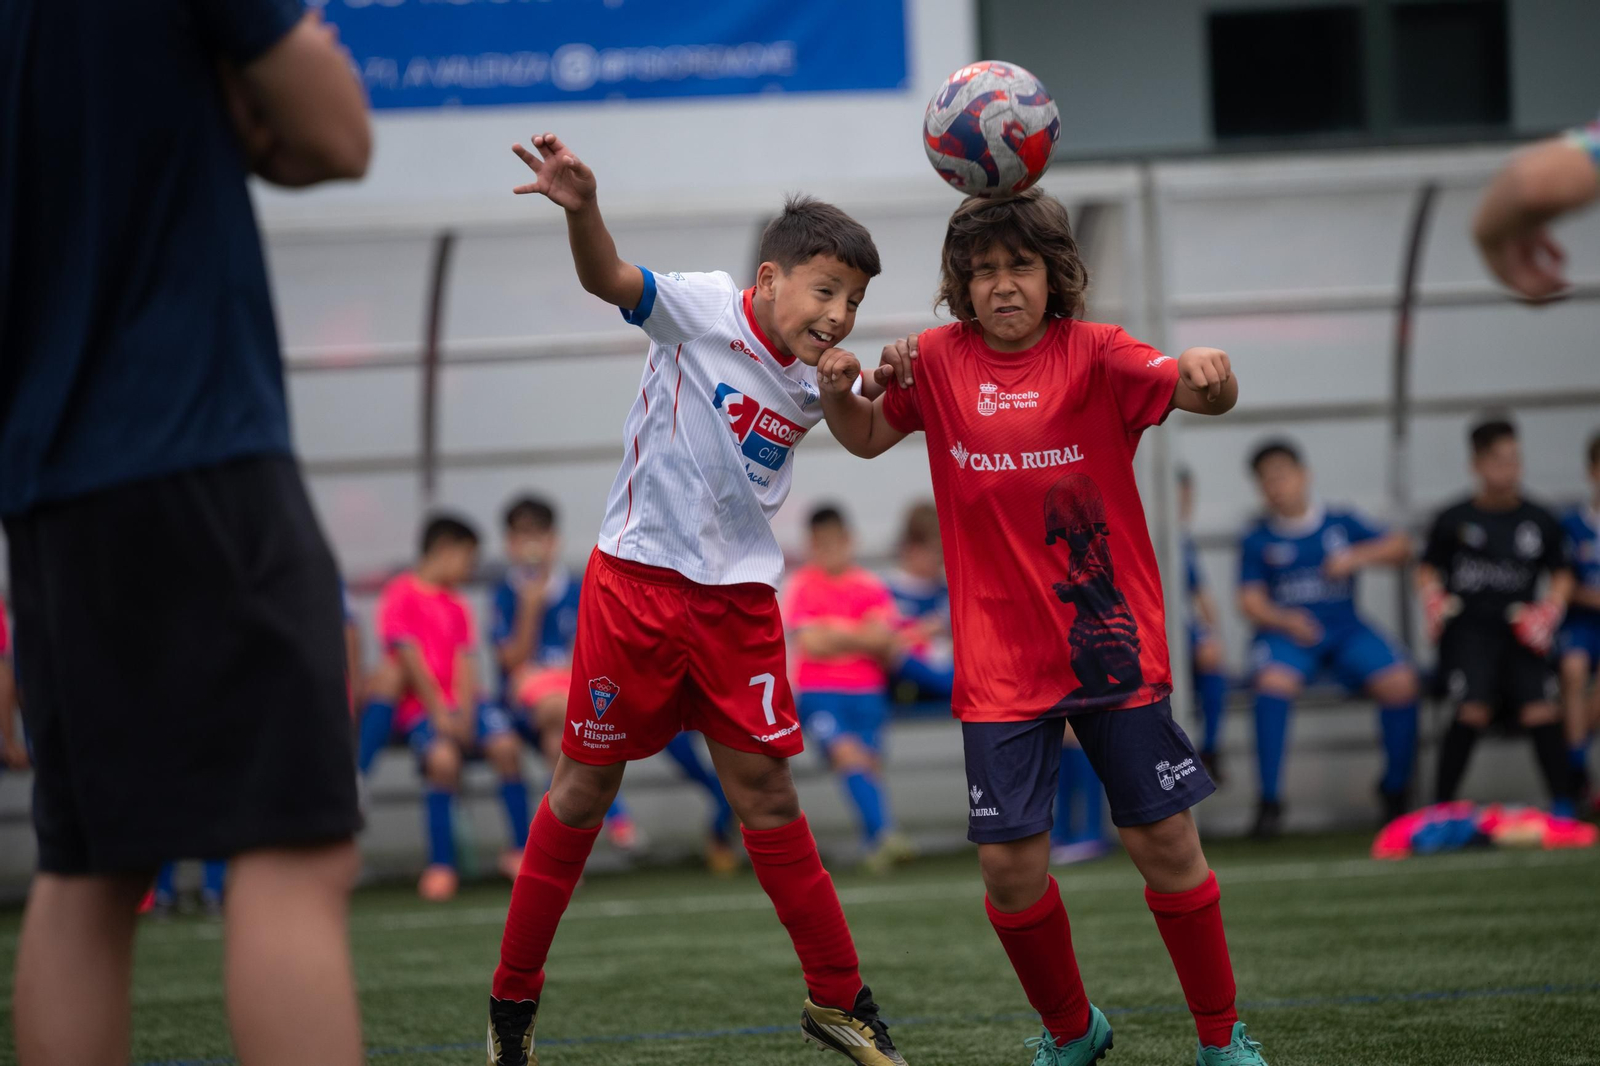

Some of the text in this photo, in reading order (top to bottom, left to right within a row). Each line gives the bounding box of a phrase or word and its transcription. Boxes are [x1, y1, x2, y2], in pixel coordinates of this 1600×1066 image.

[999, 391, 1039, 400] Concello
[998, 401, 1011, 409] de
[758, 446, 781, 467] city
[969, 444, 1084, 472] CAJA RURAL
[748, 672, 777, 726] 7
[585, 719, 615, 731] Norte
[583, 729, 627, 742] Hispana
[582, 740, 610, 749] Seguros
[1171, 758, 1194, 773] Concello
[975, 807, 999, 817] RURAL
